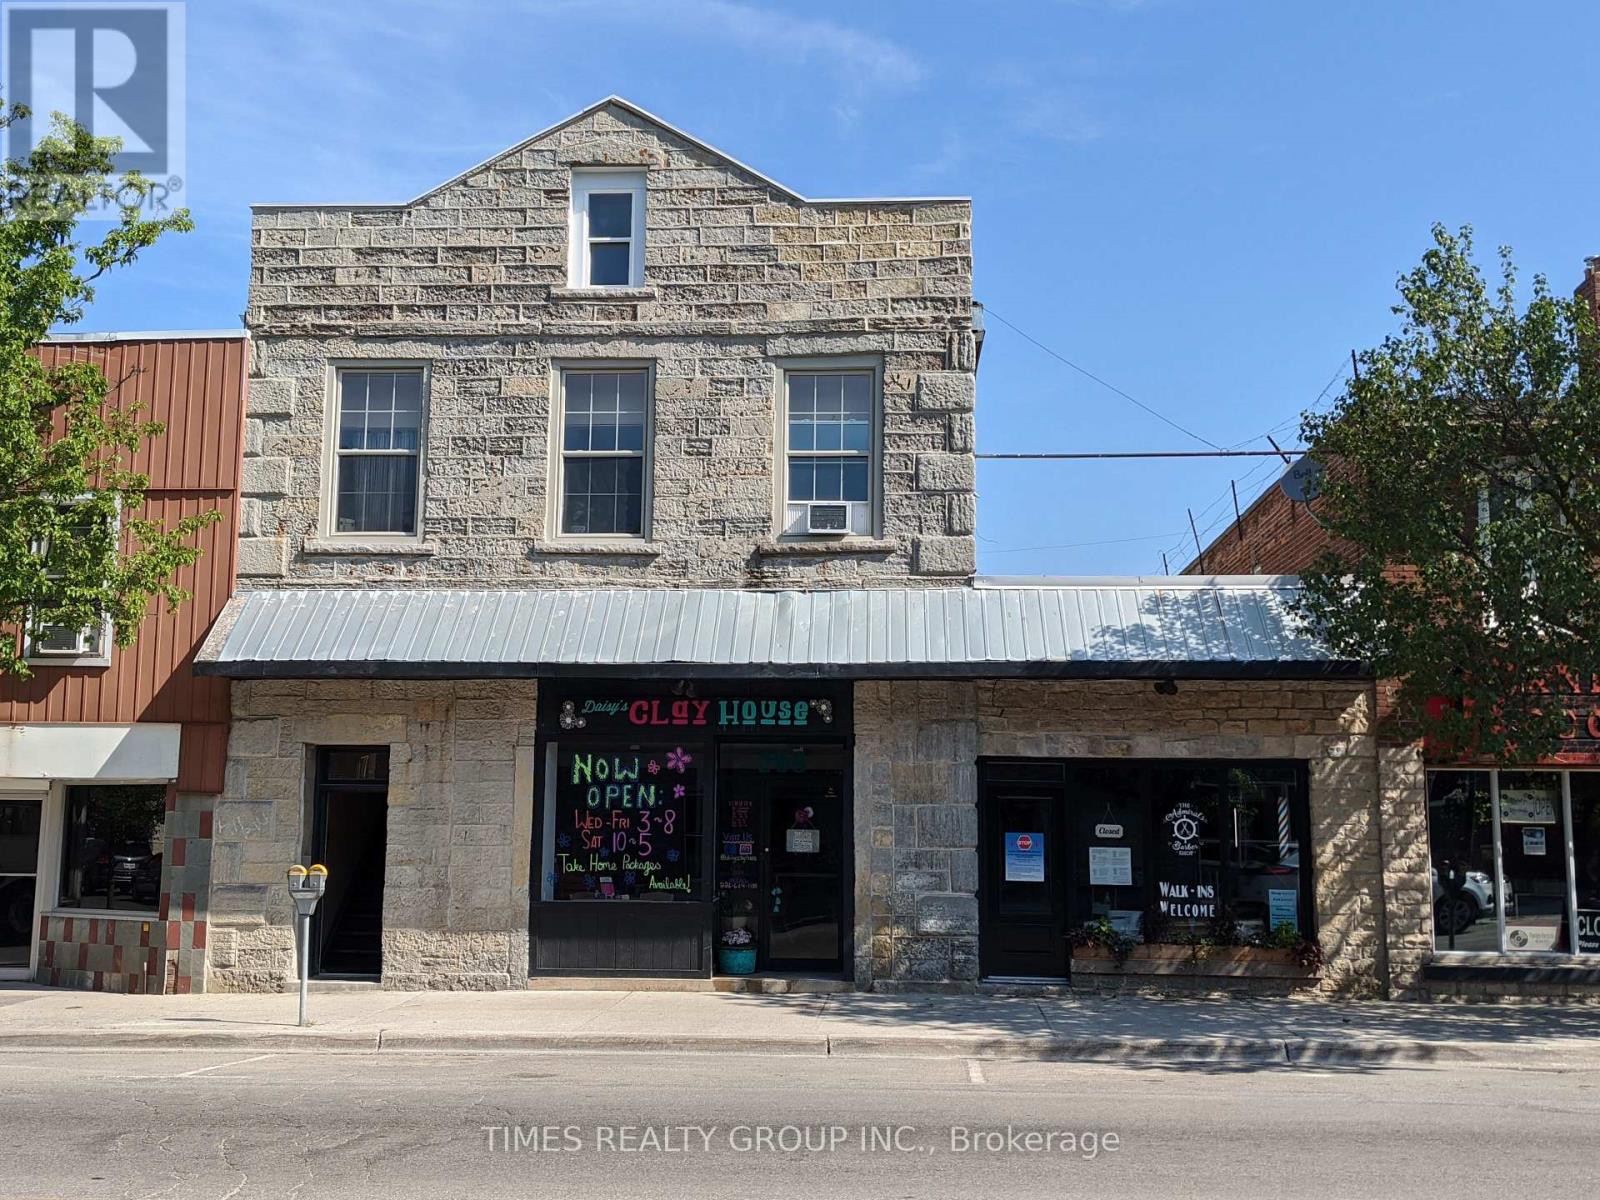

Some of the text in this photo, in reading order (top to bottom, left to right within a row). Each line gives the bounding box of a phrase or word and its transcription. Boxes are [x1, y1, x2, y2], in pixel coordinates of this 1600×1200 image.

[581, 699, 629, 716] Daisy's
[573, 754, 639, 784] NOW
[557, 853, 662, 876] Take Home Packages
[1159, 900, 1216, 917] WELCOME
